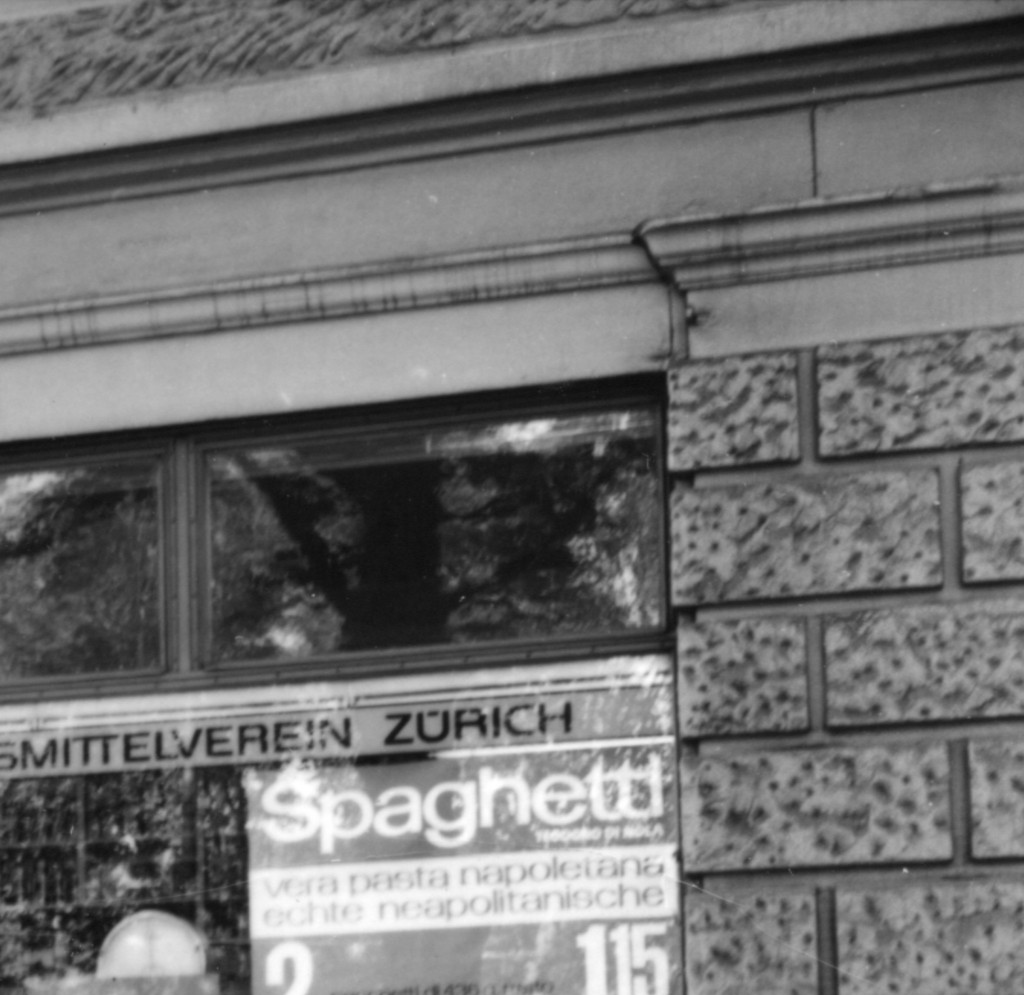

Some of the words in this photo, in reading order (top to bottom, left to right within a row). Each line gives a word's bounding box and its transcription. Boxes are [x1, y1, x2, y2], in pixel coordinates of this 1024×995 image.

[384, 701, 574, 746] ZÜRICH
[261, 753, 664, 854] Spaghetti
[263, 873, 339, 898] vera
[348, 866, 451, 897] pasta
[459, 855, 665, 887] napoletana
[262, 900, 363, 927] echte
[378, 882, 665, 921] neapolitanische
